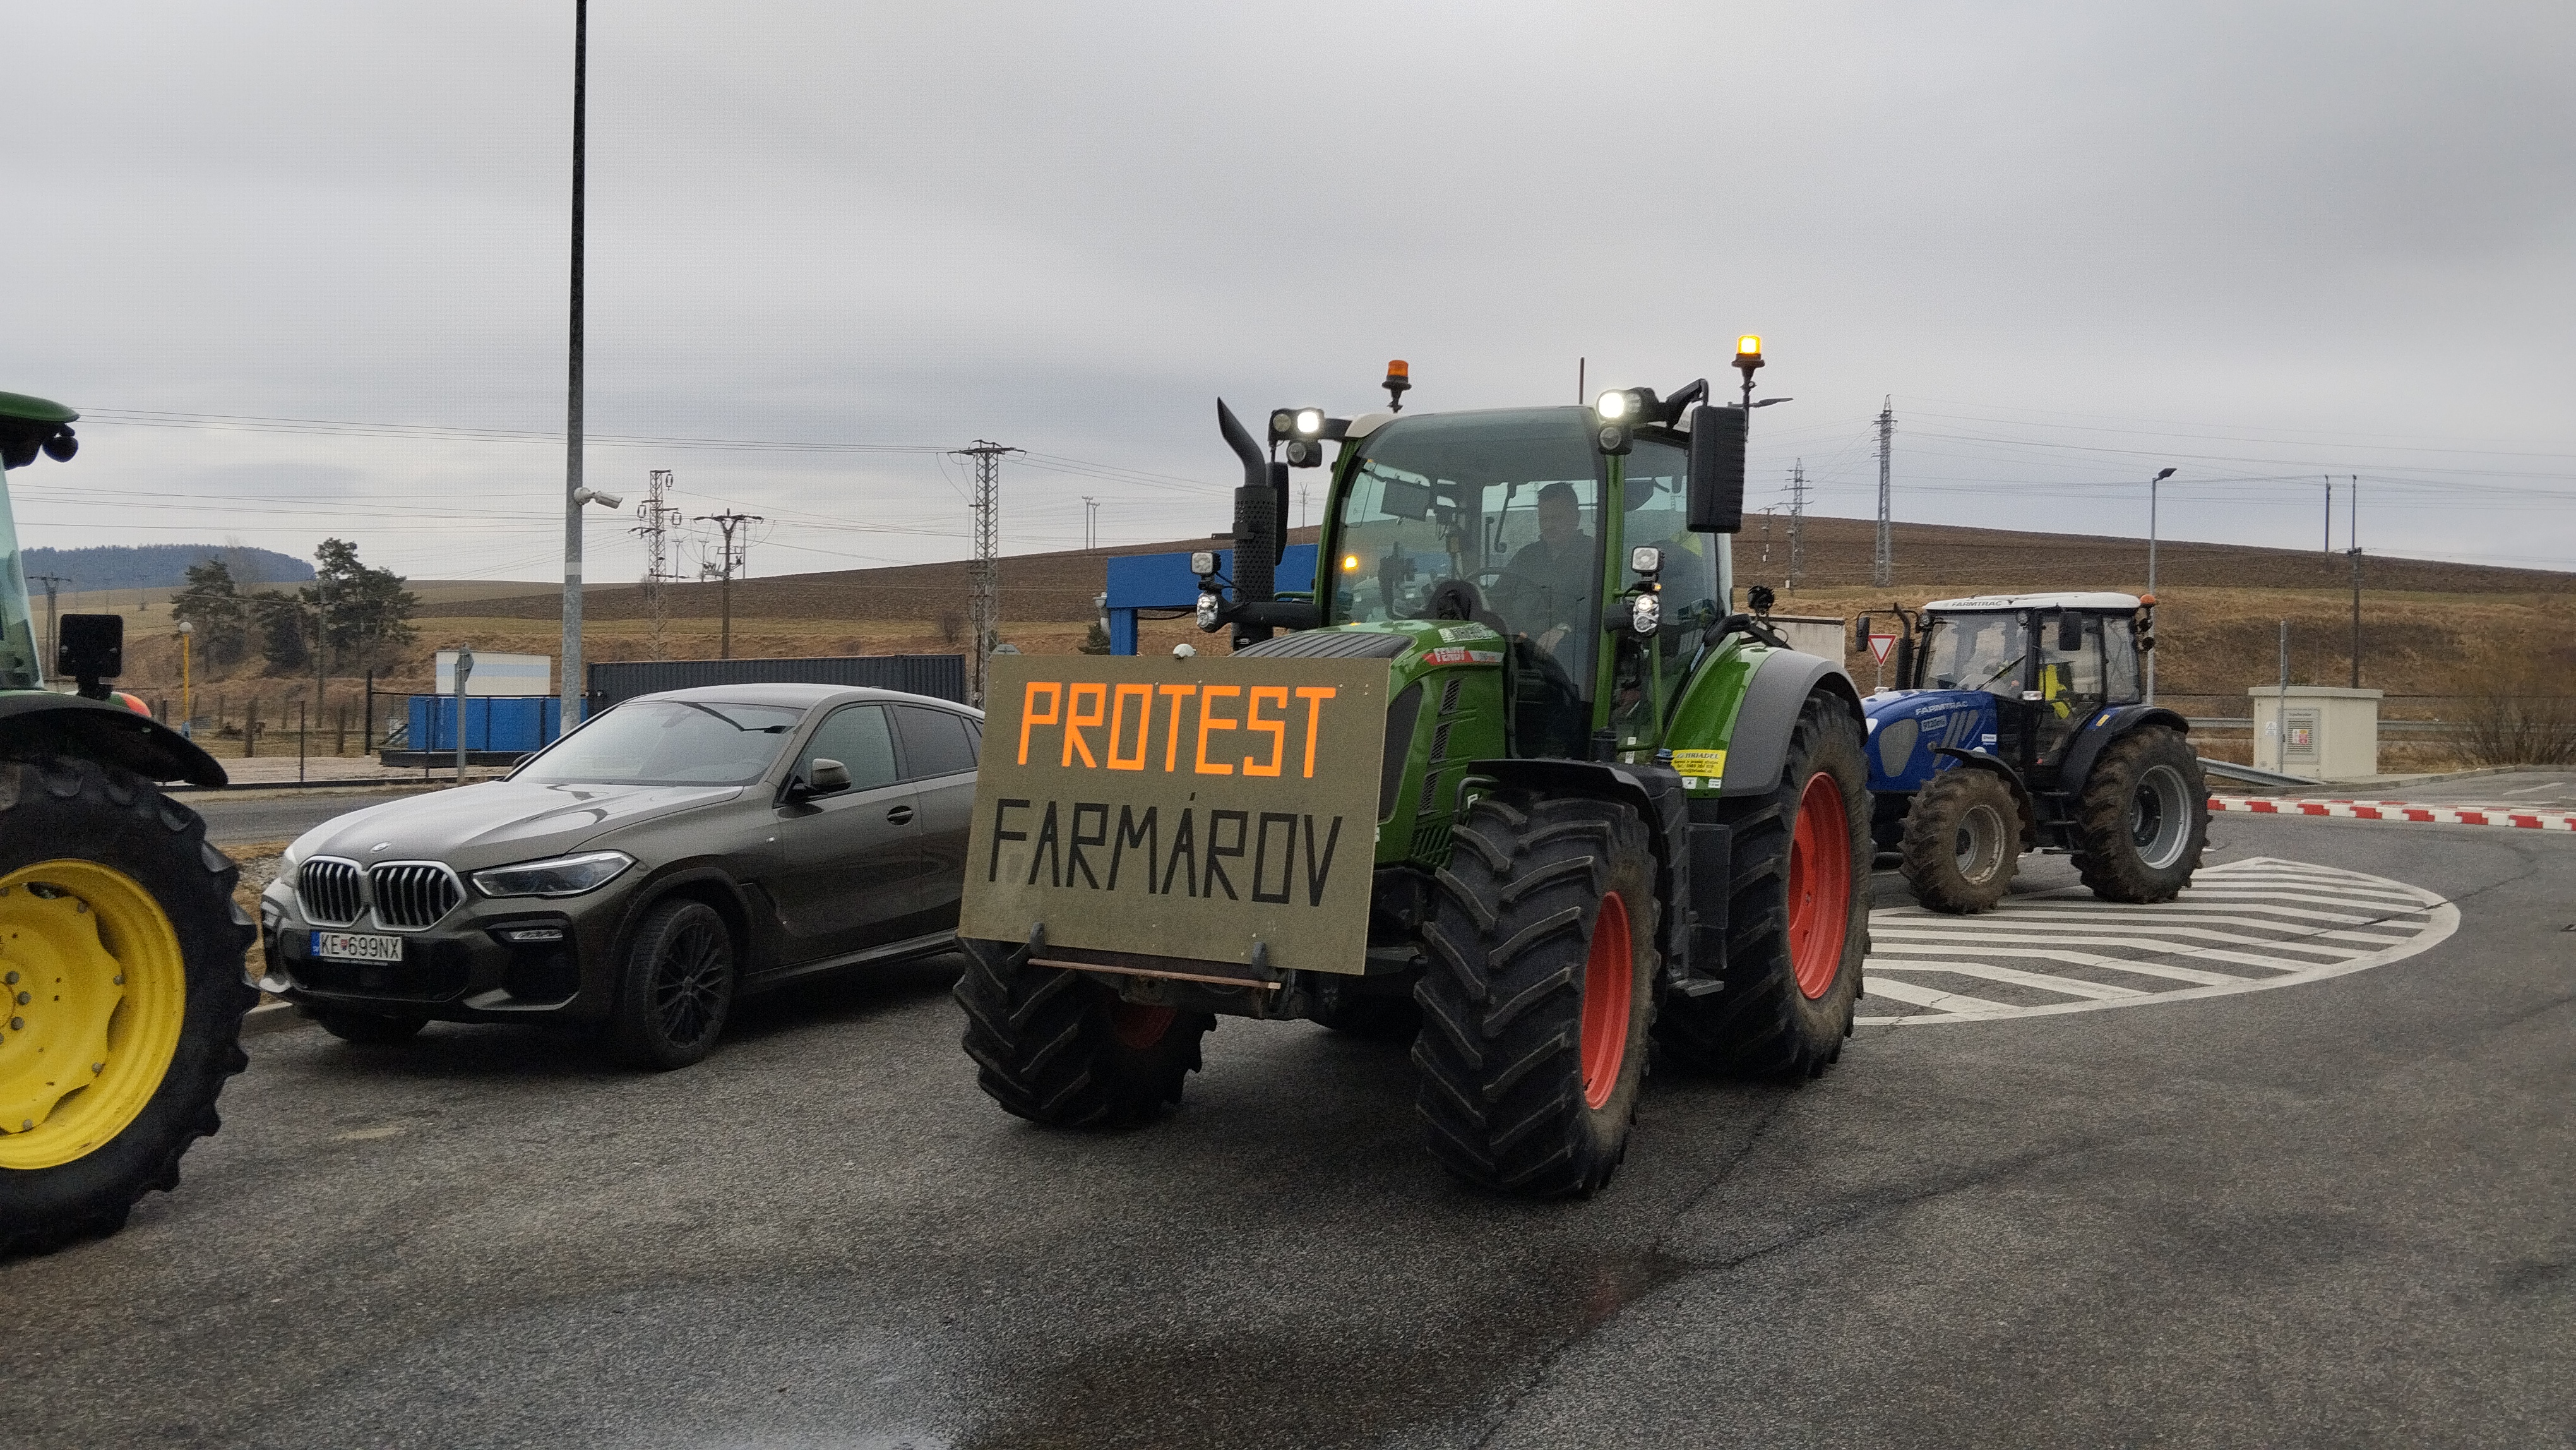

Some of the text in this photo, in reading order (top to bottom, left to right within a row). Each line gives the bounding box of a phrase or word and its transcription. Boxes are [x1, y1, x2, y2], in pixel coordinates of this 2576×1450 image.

[1434, 647, 1465, 662] FENDT
[1017, 681, 1336, 778] PROTEST
[1916, 701, 1969, 715] FARMTRAC
[988, 792, 1343, 907] FARMÁROV
